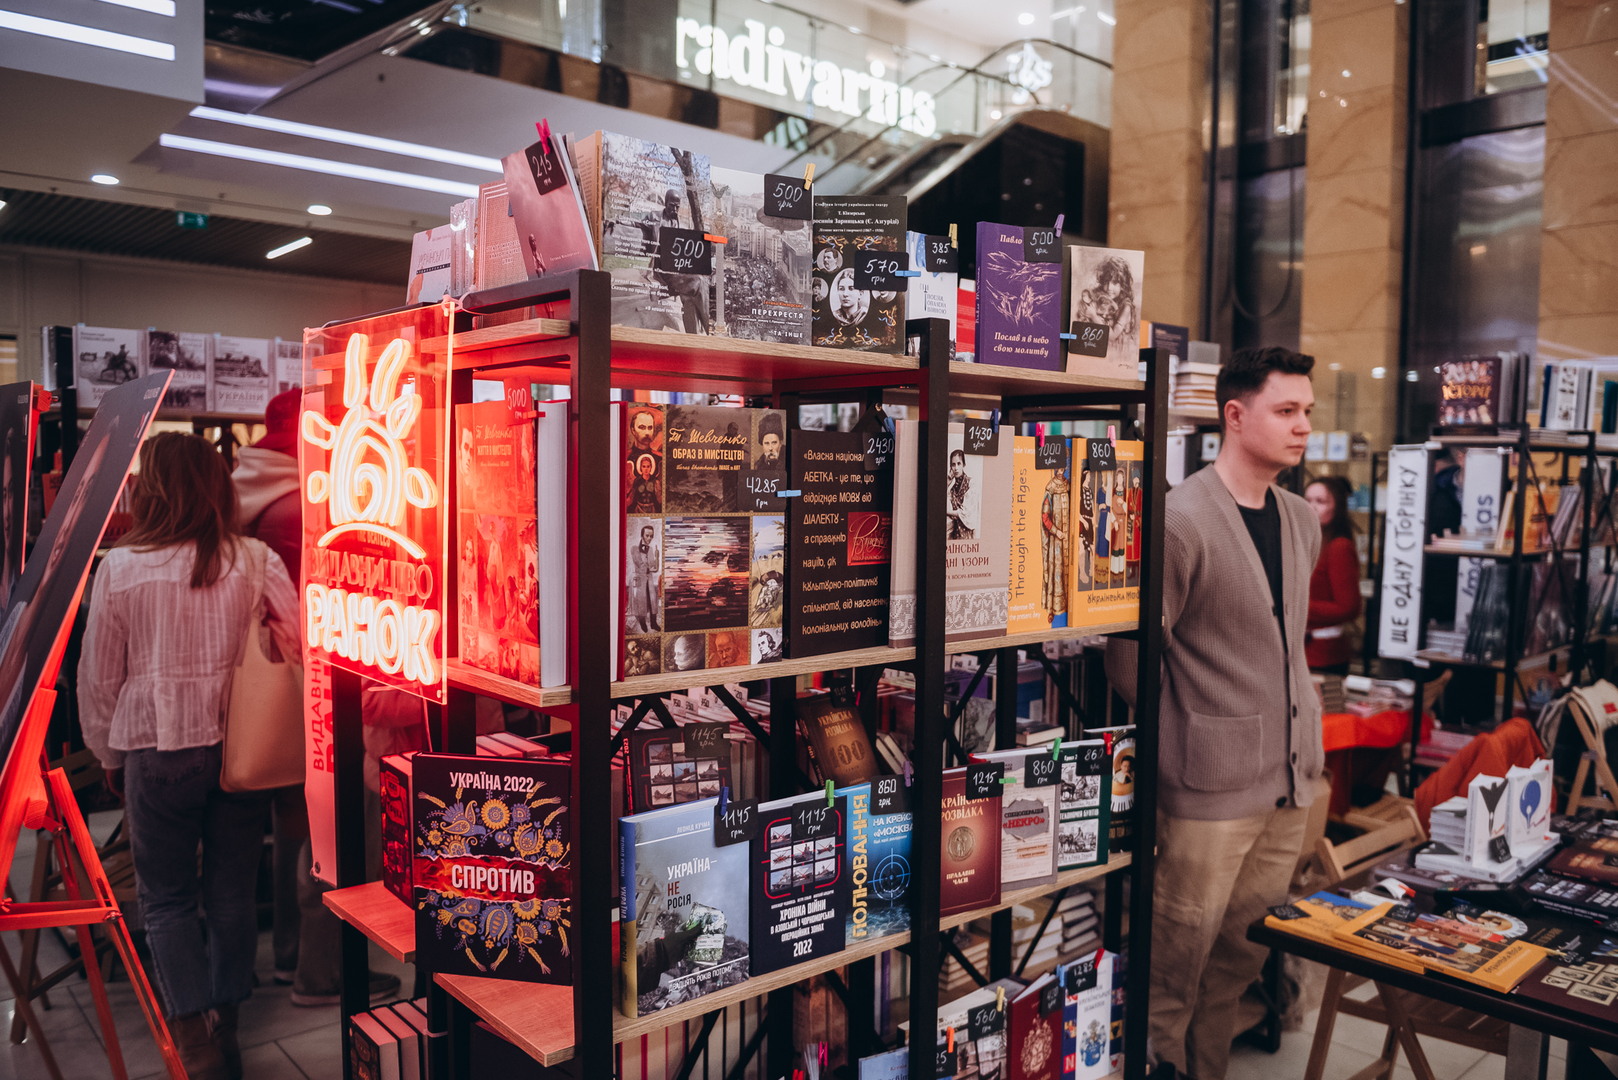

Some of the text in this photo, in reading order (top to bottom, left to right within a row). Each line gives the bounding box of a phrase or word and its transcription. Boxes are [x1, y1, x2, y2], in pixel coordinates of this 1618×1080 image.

[772, 182, 803, 203] 500
[999, 234, 1023, 245] Павло
[1029, 231, 1053, 246] 500
[670, 236, 704, 260] 500
[931, 242, 950, 254] 385
[674, 258, 694, 271] грн
[864, 258, 899, 274] 570
[751, 308, 804, 319] ПЕРЕХРЕСТЯ
[994, 331, 1021, 342] Послав
[1027, 334, 1033, 342] в
[1033, 334, 1049, 345] небо
[1081, 326, 1103, 341] 860
[993, 345, 1049, 358] свою молитву
[688, 428, 748, 445] Шевченко
[968, 425, 993, 441] 1430
[867, 437, 895, 455] 2430
[1038, 442, 1061, 456] 1000
[1091, 442, 1111, 458] 860
[672, 448, 744, 462] ОБРАЗ В МИСТЕЦТВІ
[803, 449, 834, 461] «Власна
[746, 476, 780, 494] 4285
[803, 471, 875, 485] АБЕТКА це те, що
[1016, 467, 1031, 503] Ages
[803, 492, 838, 506] відрізняє
[861, 492, 872, 503] від
[1015, 508, 1027, 533] the
[804, 532, 847, 546] а справжню
[802, 556, 826, 570] націю,
[961, 556, 990, 570] УЗОРИ
[1014, 537, 1029, 599] Through
[309, 546, 434, 601] ВИДАВНИЦТВО
[842, 598, 853, 610] від
[1017, 614, 1032, 622] present
[305, 583, 441, 686] РАНОК
[802, 621, 849, 636] колоніальних
[817, 710, 853, 727] УКРАЇНСЬКА
[691, 726, 723, 741] 1145
[1084, 748, 1104, 761] 860
[1032, 759, 1055, 776] 860
[449, 771, 534, 793] УКРАЇНА 2022
[877, 778, 897, 794] 860
[972, 770, 998, 786] 1215
[878, 797, 892, 808] грн
[721, 805, 752, 828] 1145
[798, 807, 831, 825] 1145
[873, 816, 885, 827] НА
[1004, 808, 1044, 819] СПЕЦОПЕРАЦІЯ
[676, 821, 711, 834] ЛЕОНІД КУЧМА
[1002, 815, 1045, 829] «НЕКРО»
[852, 794, 869, 938] ПОЛЮВАННЯ
[451, 863, 535, 895] СПРОТИВ
[667, 881, 680, 897] НЕ
[619, 886, 628, 920] УКРАЇНА
[667, 893, 692, 911] РОСІЯ
[779, 904, 806, 922] ХРОНІКА
[807, 898, 827, 915] ВІЙНИ
[770, 925, 775, 935] В
[811, 922, 825, 935] ЗОНАХ
[793, 938, 813, 958] 2022
[1073, 960, 1095, 977] 1285
[668, 964, 734, 992] ДВАДЦЯТЬ РОКІВ ПОТОМУ
[974, 1008, 997, 1026] 560
